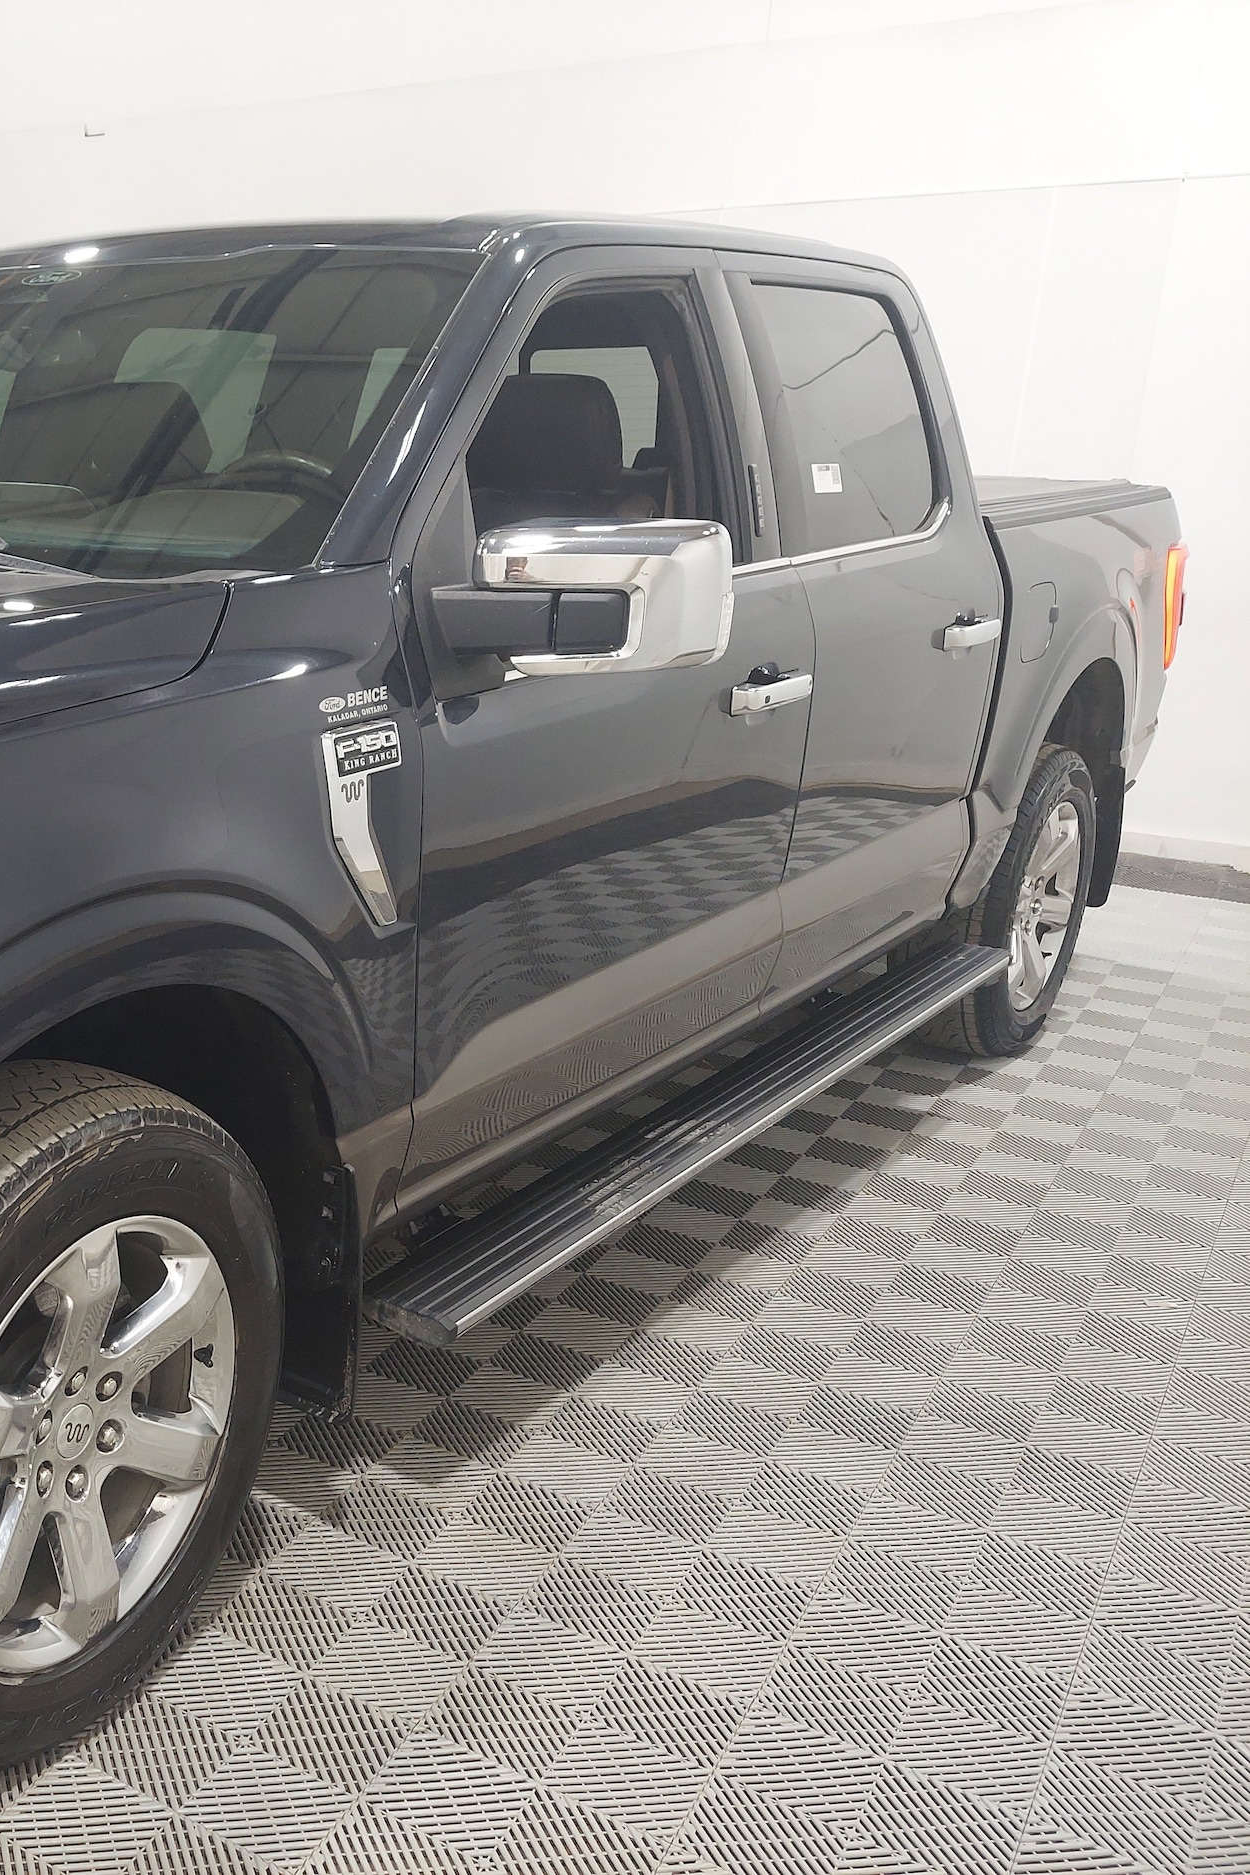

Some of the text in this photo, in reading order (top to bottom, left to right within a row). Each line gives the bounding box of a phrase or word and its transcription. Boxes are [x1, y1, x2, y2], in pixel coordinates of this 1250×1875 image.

[347, 686, 388, 707] BENCE
[327, 704, 388, 723] KALADAR, ONTARIO
[336, 731, 397, 758] F-150
[344, 749, 397, 770] KING RANCH
[42, 1160, 183, 1240] PIRELLI
